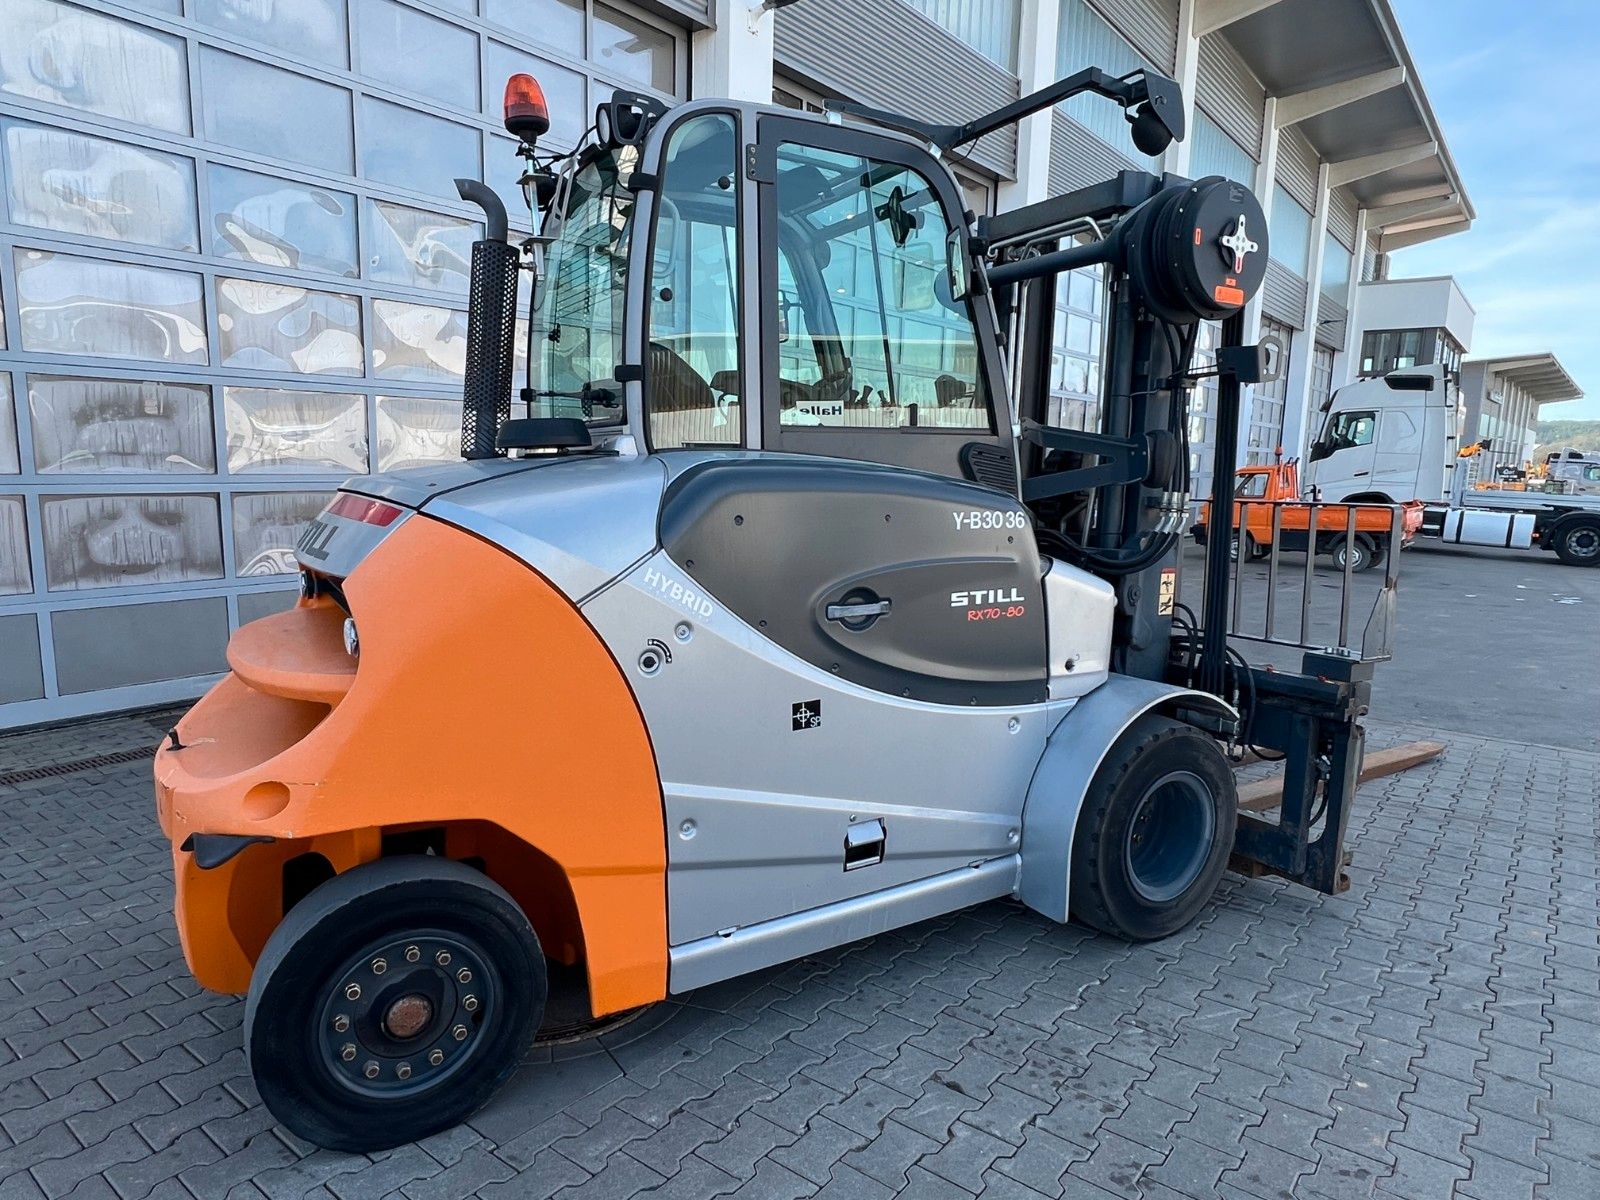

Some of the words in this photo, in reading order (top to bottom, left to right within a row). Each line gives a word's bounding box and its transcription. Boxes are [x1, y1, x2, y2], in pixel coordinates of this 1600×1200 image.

[644, 567, 714, 617] HYBRID
[951, 588, 1025, 607] STILL
[968, 606, 1024, 621] RX70-80
